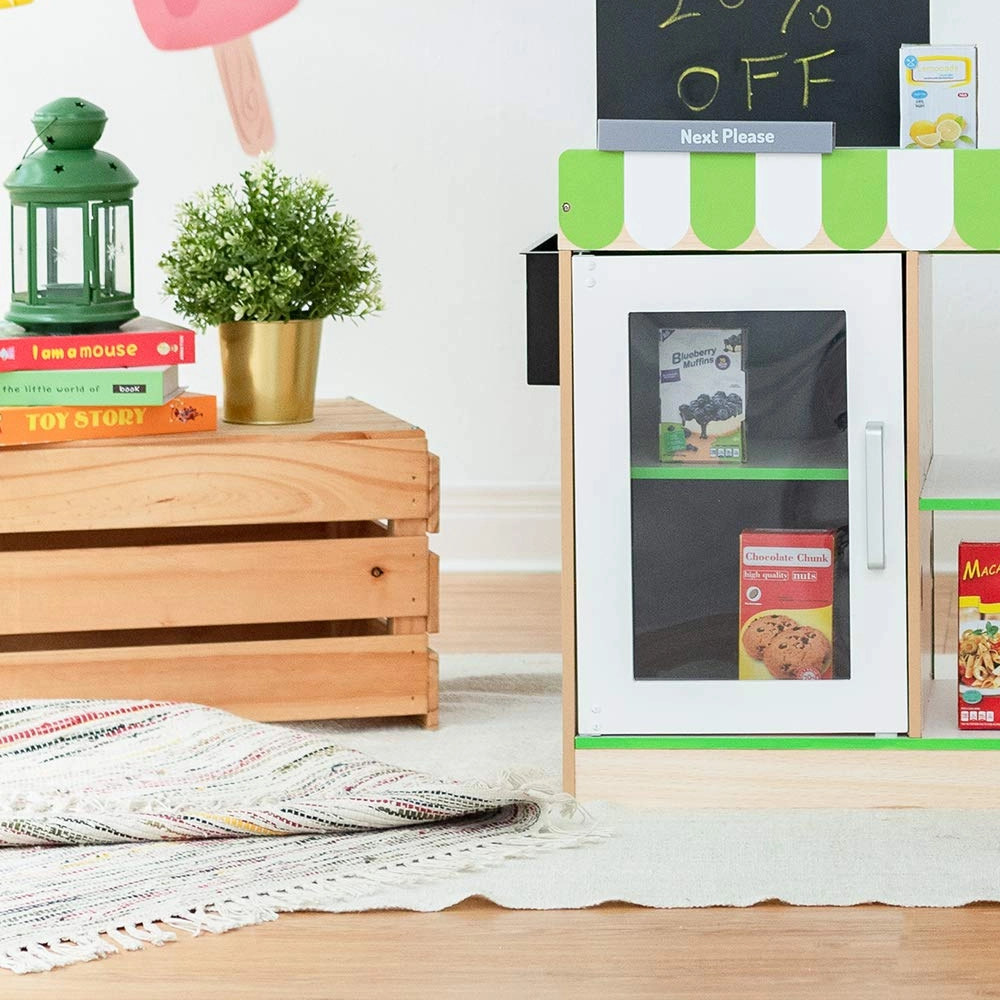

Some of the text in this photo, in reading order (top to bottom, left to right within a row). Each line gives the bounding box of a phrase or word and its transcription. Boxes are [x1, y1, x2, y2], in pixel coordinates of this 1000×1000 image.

[677, 49, 836, 112] OFF
[680, 127, 775, 144] Next Please
[41, 349, 64, 360] am
[67, 348, 77, 359] a
[80, 343, 138, 359] mouse
[672, 347, 717, 365] Blueberry
[683, 357, 714, 369] Muffins
[2, 385, 20, 393] the
[24, 385, 52, 393] little
[56, 385, 85, 393] world
[89, 385, 100, 393] of
[26, 408, 147, 432] TOY STORY
[745, 552, 829, 563] Chocolate Chunk
[743, 570, 817, 581] high quality nuts
